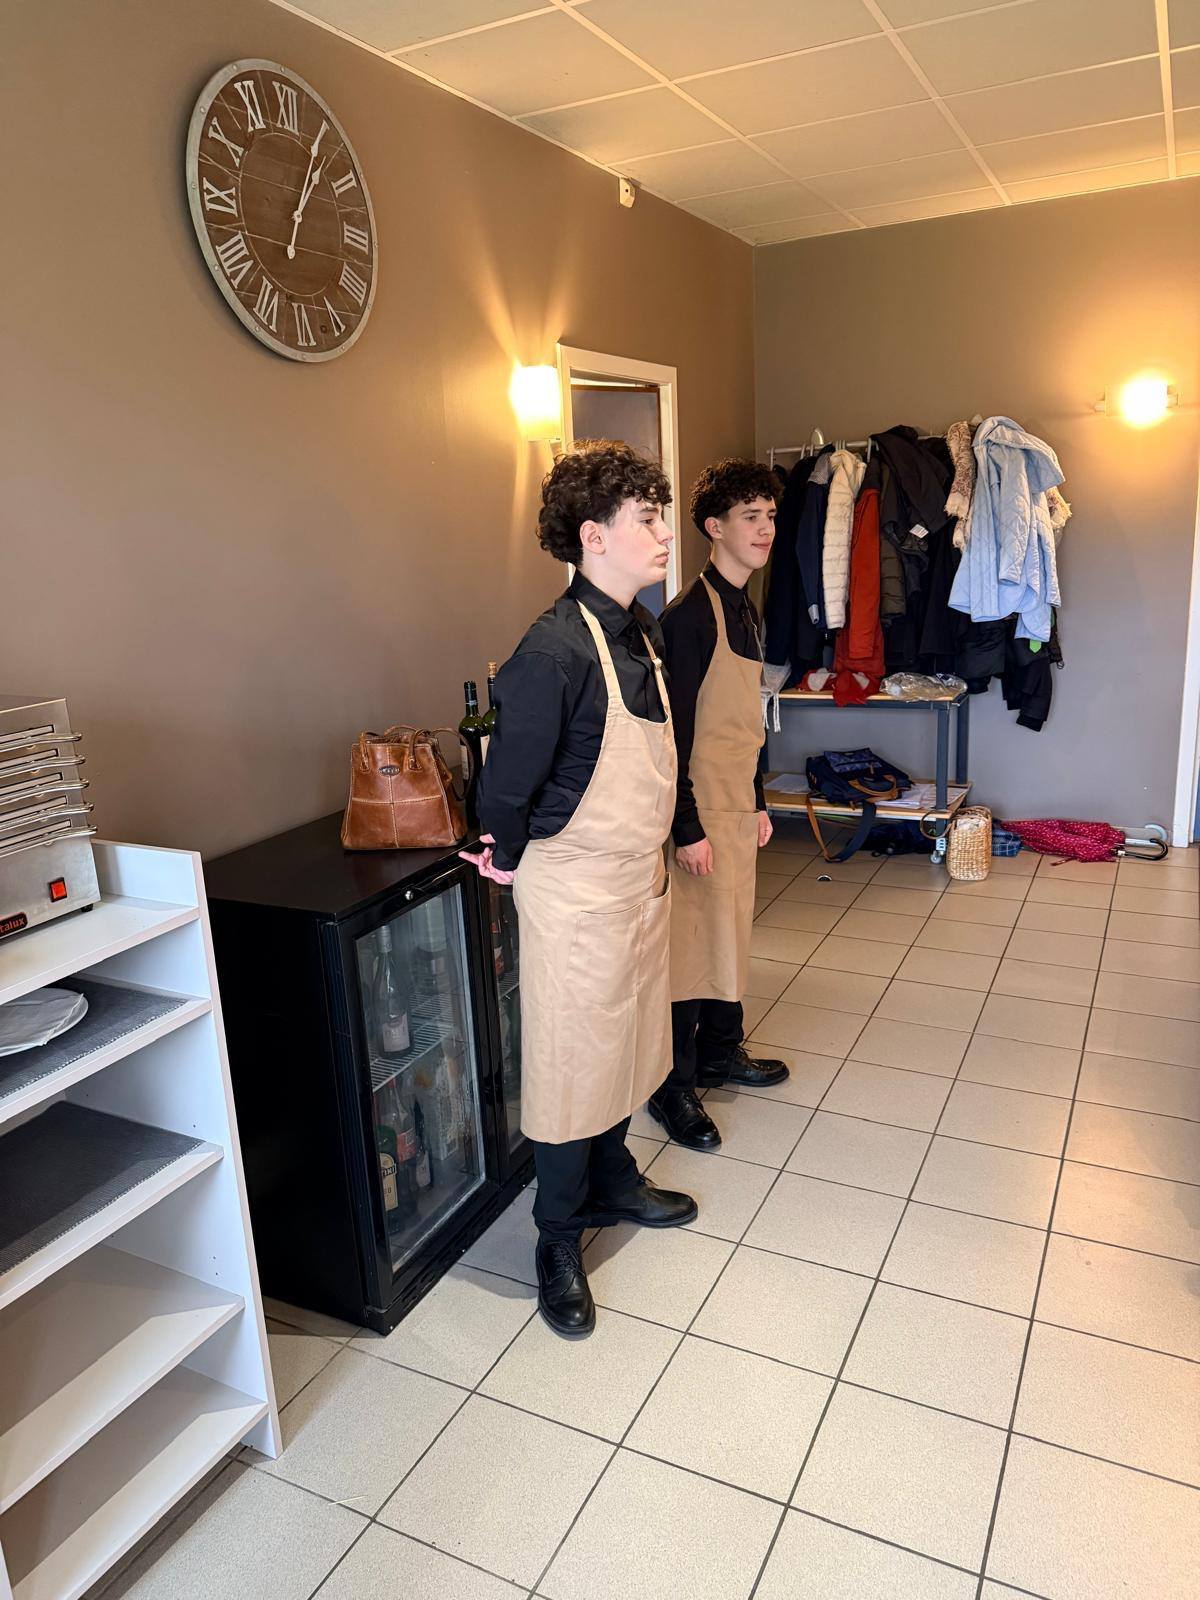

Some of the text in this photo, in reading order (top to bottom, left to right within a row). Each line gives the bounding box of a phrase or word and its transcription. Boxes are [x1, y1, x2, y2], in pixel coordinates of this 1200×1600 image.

[234, 80, 266, 132] XI
[272, 81, 300, 136] XII
[208, 117, 244, 167] X
[203, 177, 238, 217] IX
[331, 168, 357, 198] II
[216, 230, 254, 289] VIII
[343, 221, 369, 255] III
[253, 275, 279, 333] VII
[338, 261, 367, 307] IIII
[292, 302, 316, 346] VI
[323, 296, 346, 337] V
